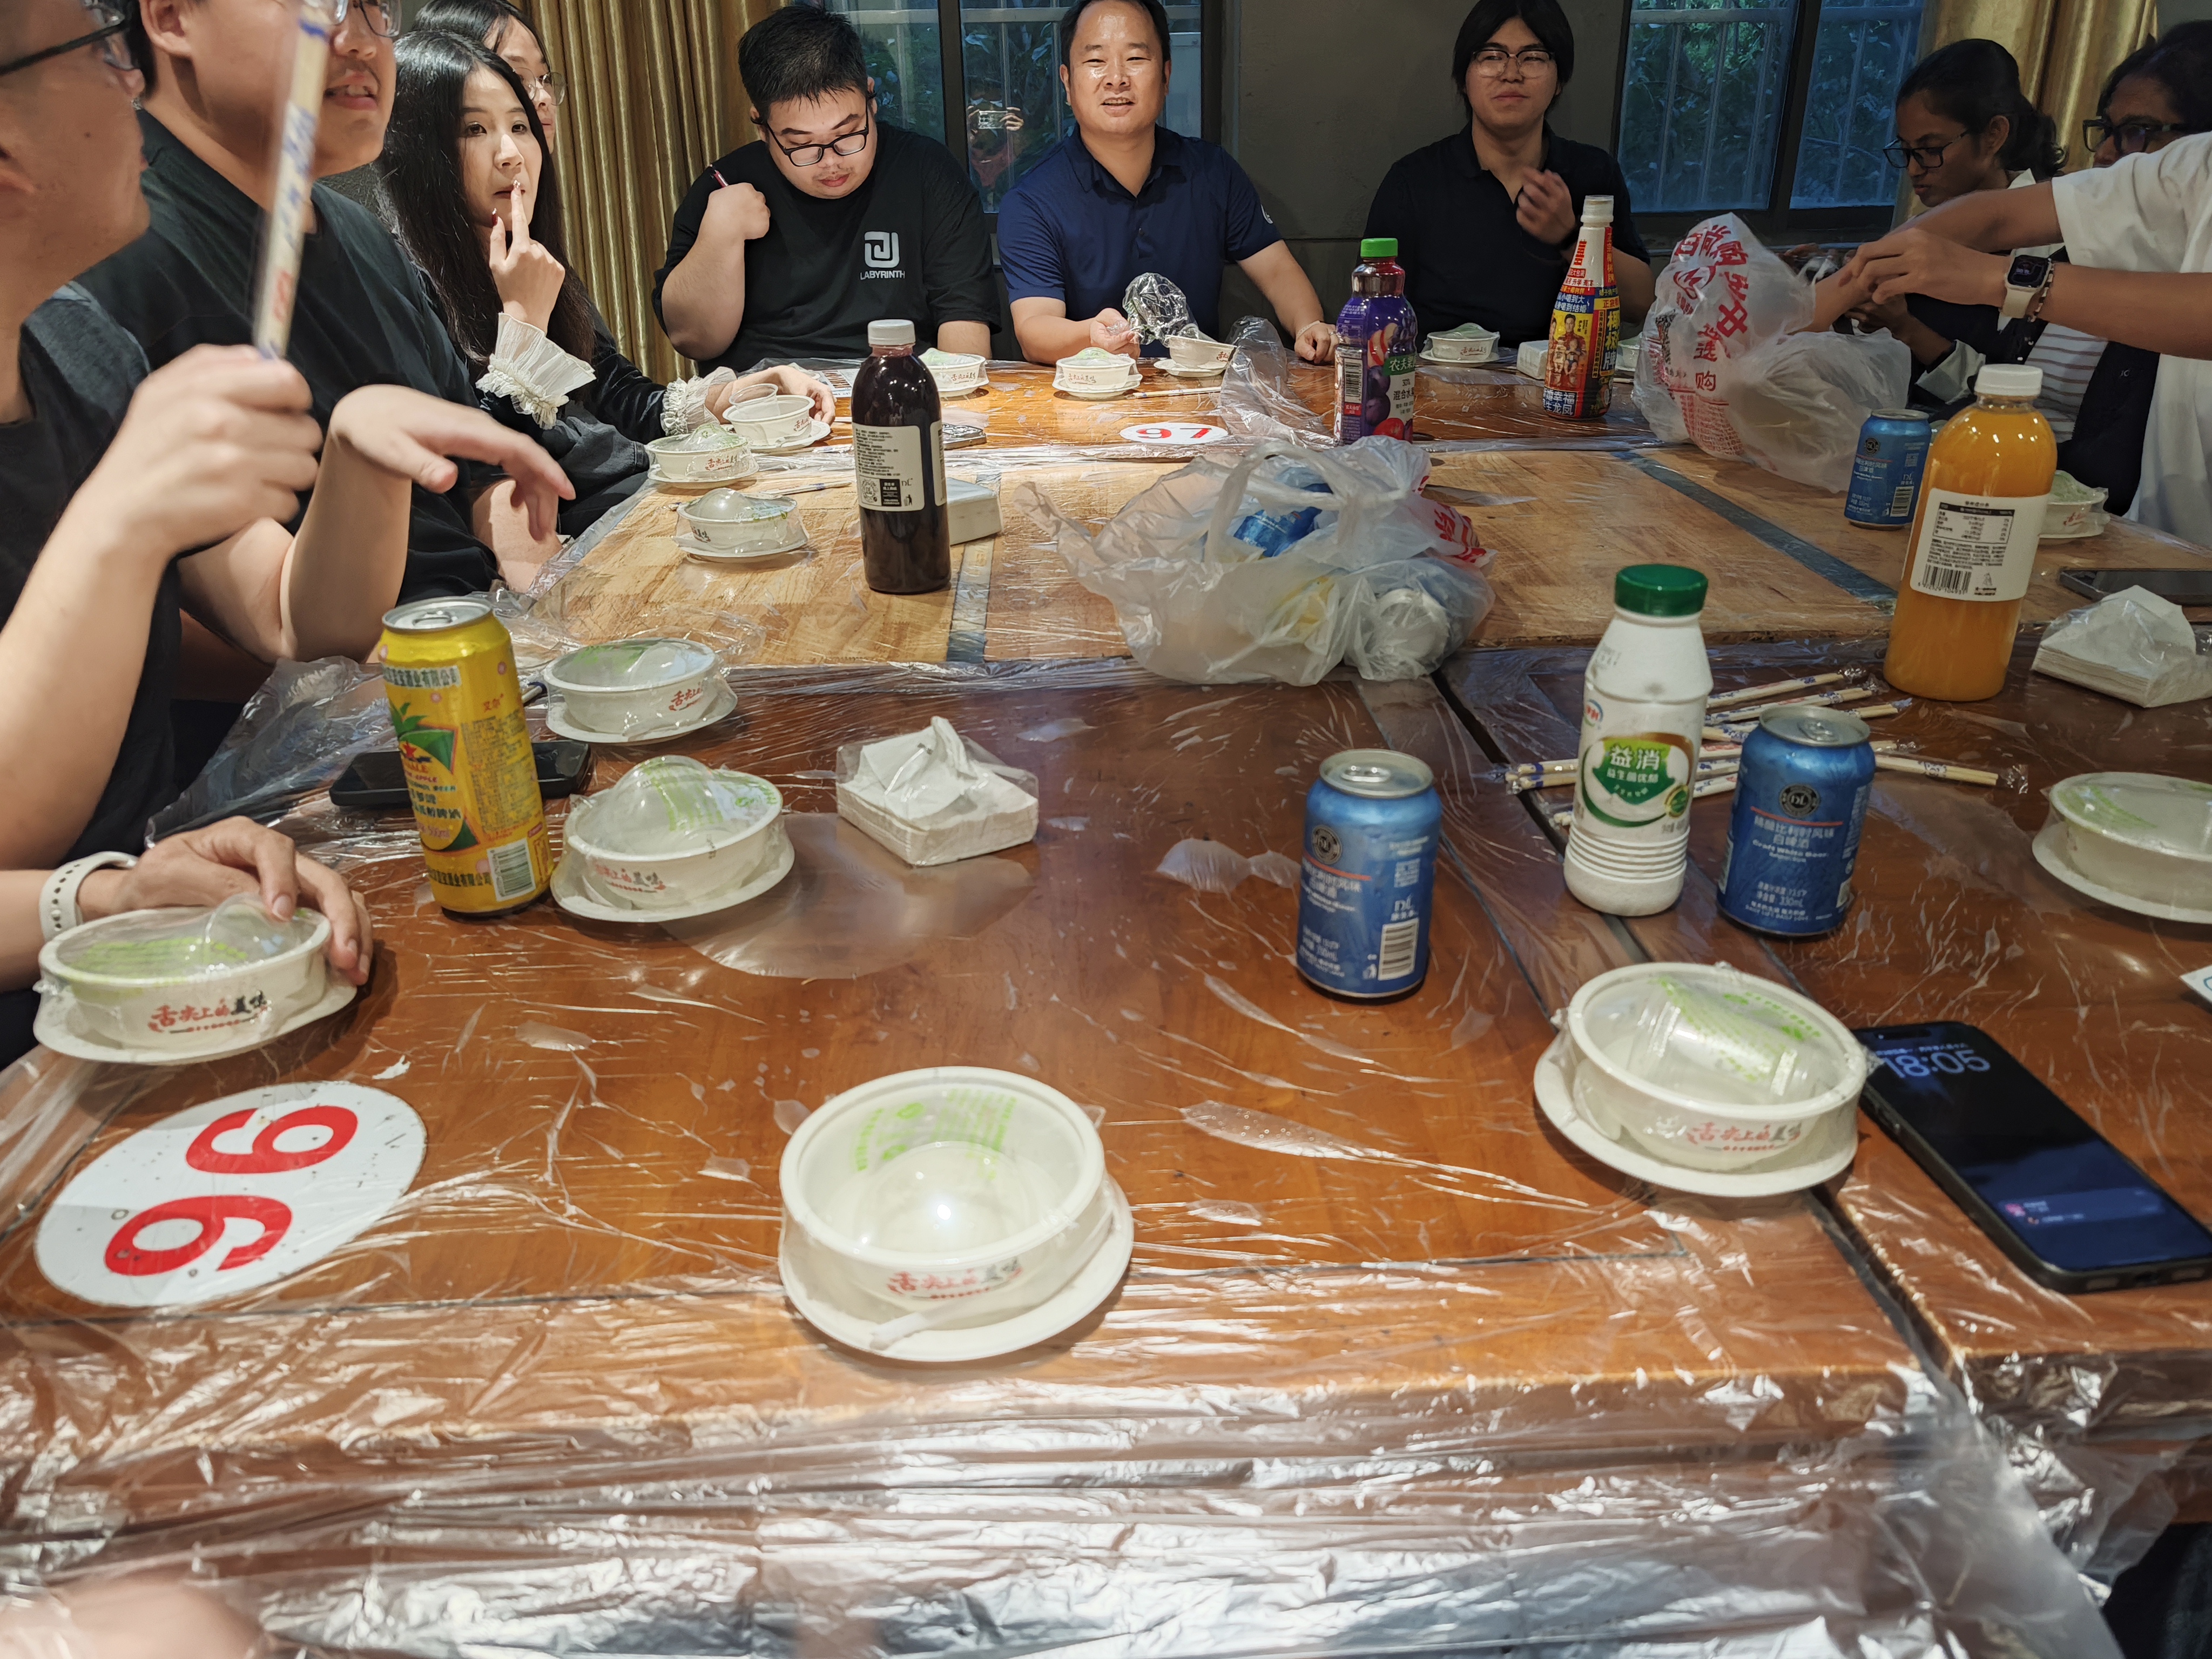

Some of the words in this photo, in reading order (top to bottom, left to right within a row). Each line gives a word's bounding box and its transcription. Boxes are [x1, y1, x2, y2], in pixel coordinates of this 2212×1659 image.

[860, 271, 905, 280] LABYRINTH
[1136, 428, 1212, 439] 97
[1610, 744, 1660, 771] 益消
[1882, 1049, 1991, 1078] 18:05
